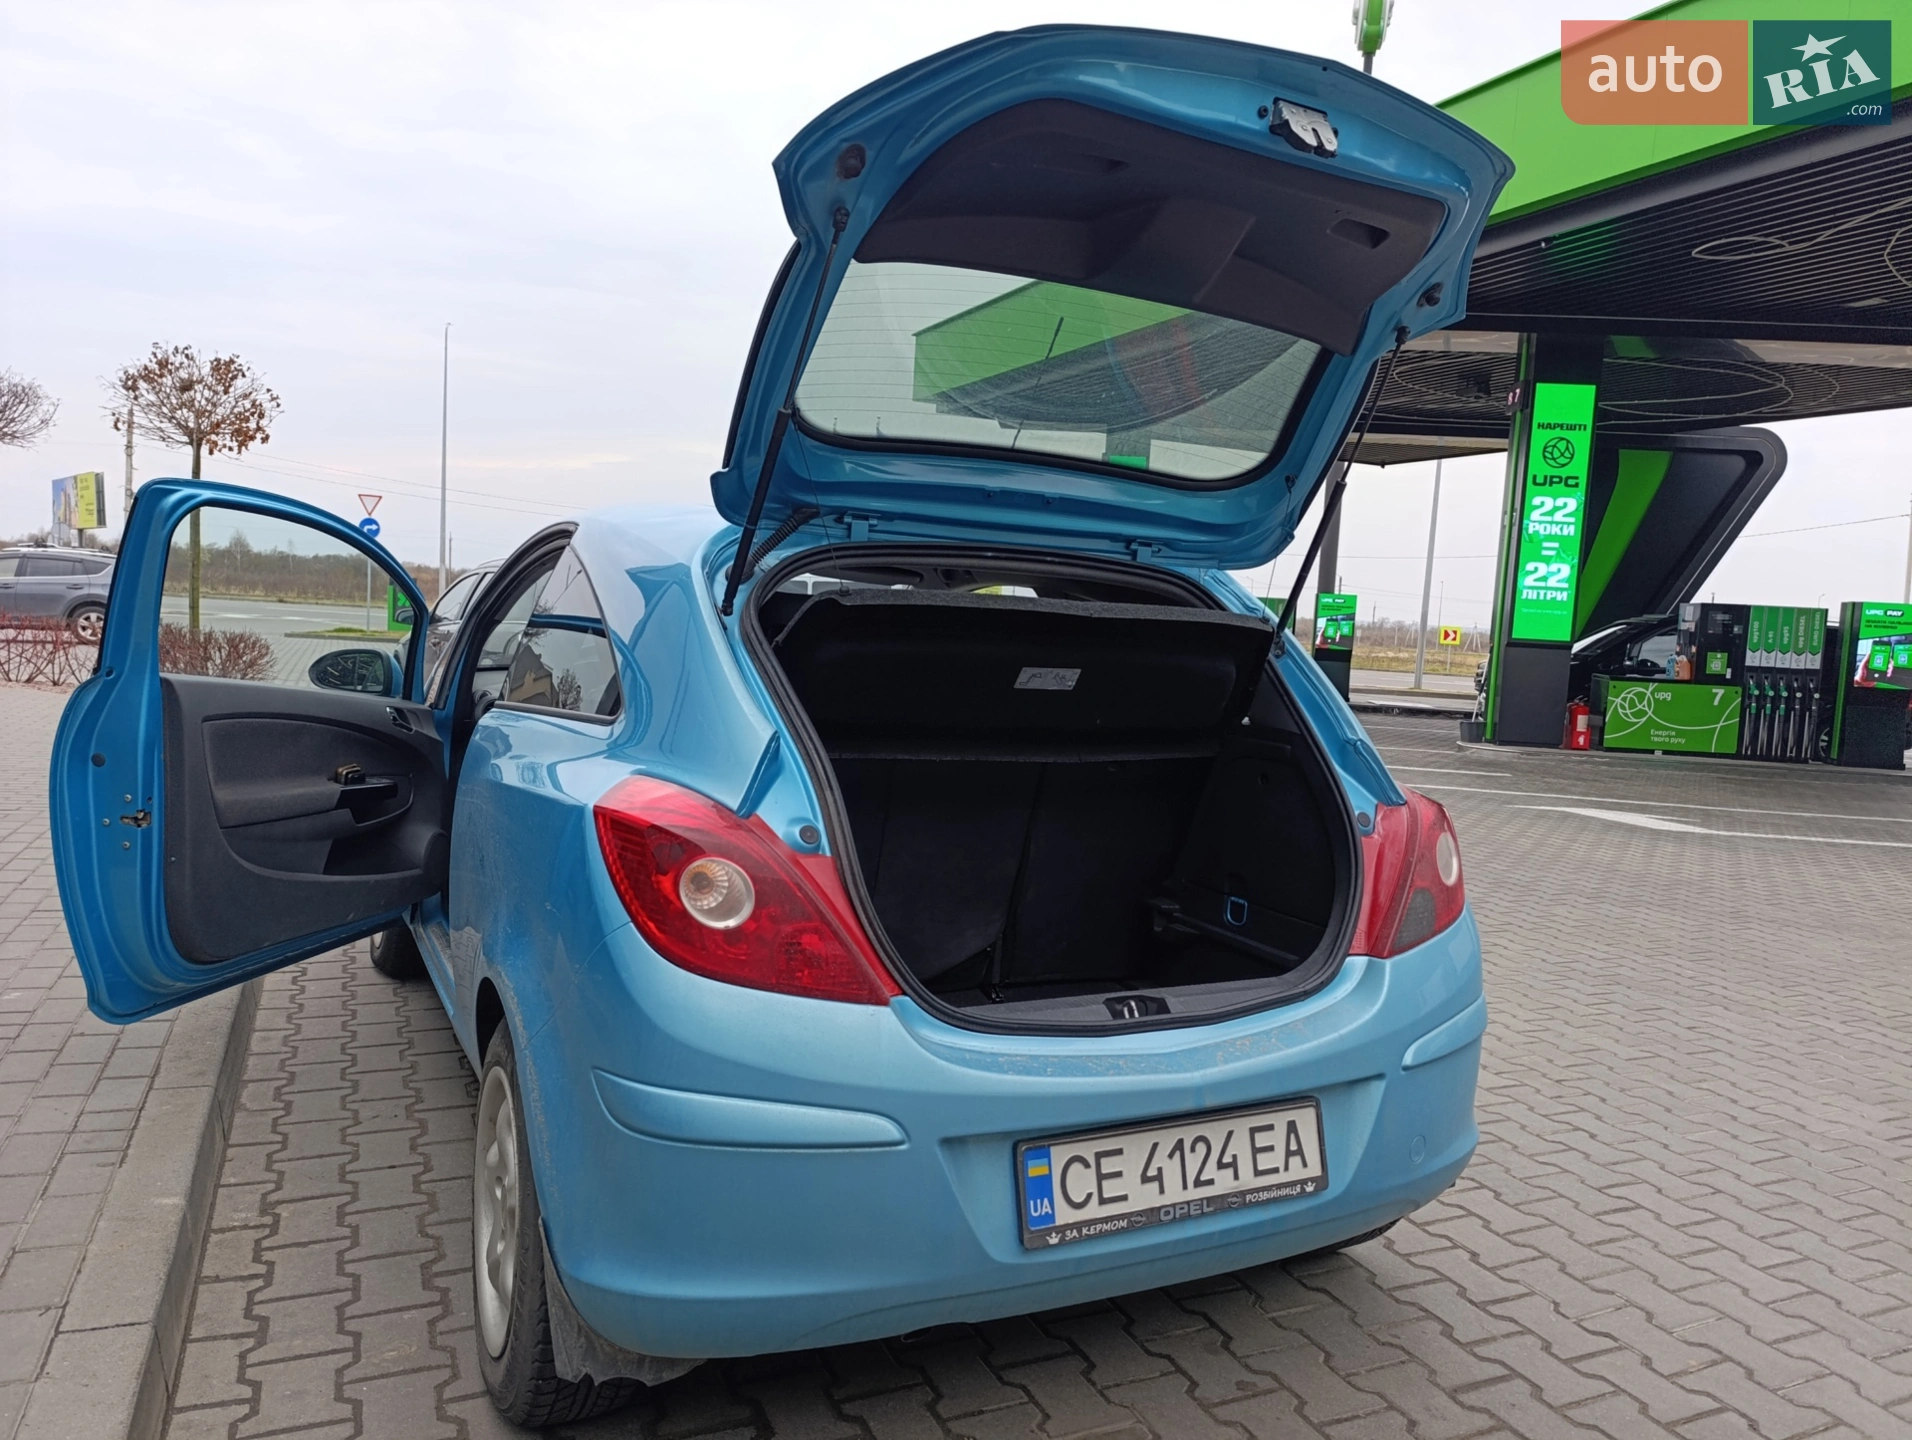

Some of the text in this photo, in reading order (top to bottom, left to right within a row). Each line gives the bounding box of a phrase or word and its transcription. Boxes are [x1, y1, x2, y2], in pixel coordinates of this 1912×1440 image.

[1537, 422, 1588, 432] НАРЕШТІ
[1532, 474, 1580, 488] UPG
[1530, 496, 1578, 523] 22
[1528, 522, 1576, 537] РОКИ
[1523, 561, 1571, 588] 22
[1654, 691, 1672, 702] upg
[1712, 688, 1725, 706] 7
[1060, 1119, 1308, 1210] CE 4124 EA
[1245, 1184, 1302, 1204] РОЗБІЙНИЦЯ
[1030, 1198, 1053, 1218] UA
[1159, 1202, 1214, 1222] OPEL
[1064, 1218, 1128, 1241] ЗА КЕРМОМ
